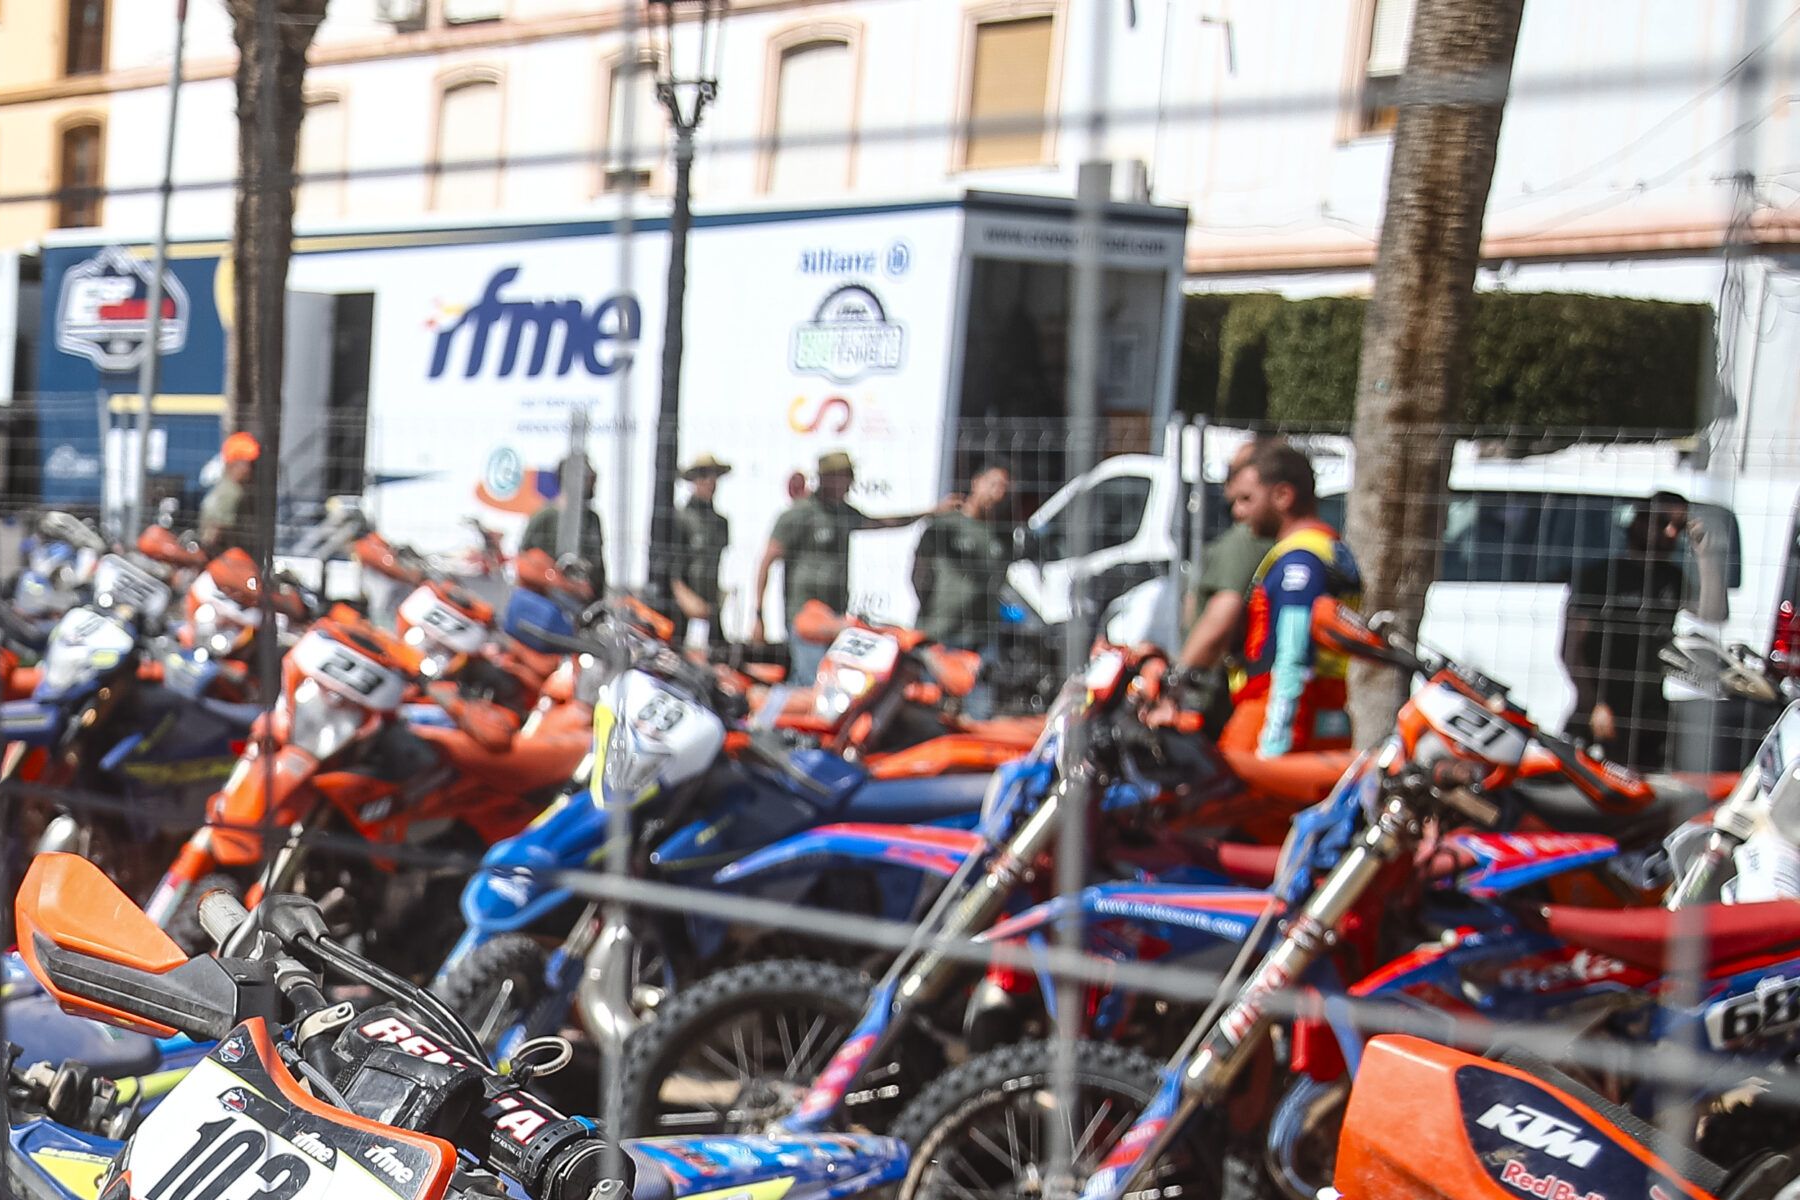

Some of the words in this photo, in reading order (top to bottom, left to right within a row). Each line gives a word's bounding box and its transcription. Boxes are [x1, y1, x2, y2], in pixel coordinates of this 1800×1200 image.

[429, 267, 641, 376] rfme
[320, 650, 384, 695] 23
[291, 1131, 336, 1163] rfme
[1476, 1103, 1601, 1168] KTM
[363, 1143, 414, 1184] rfme
